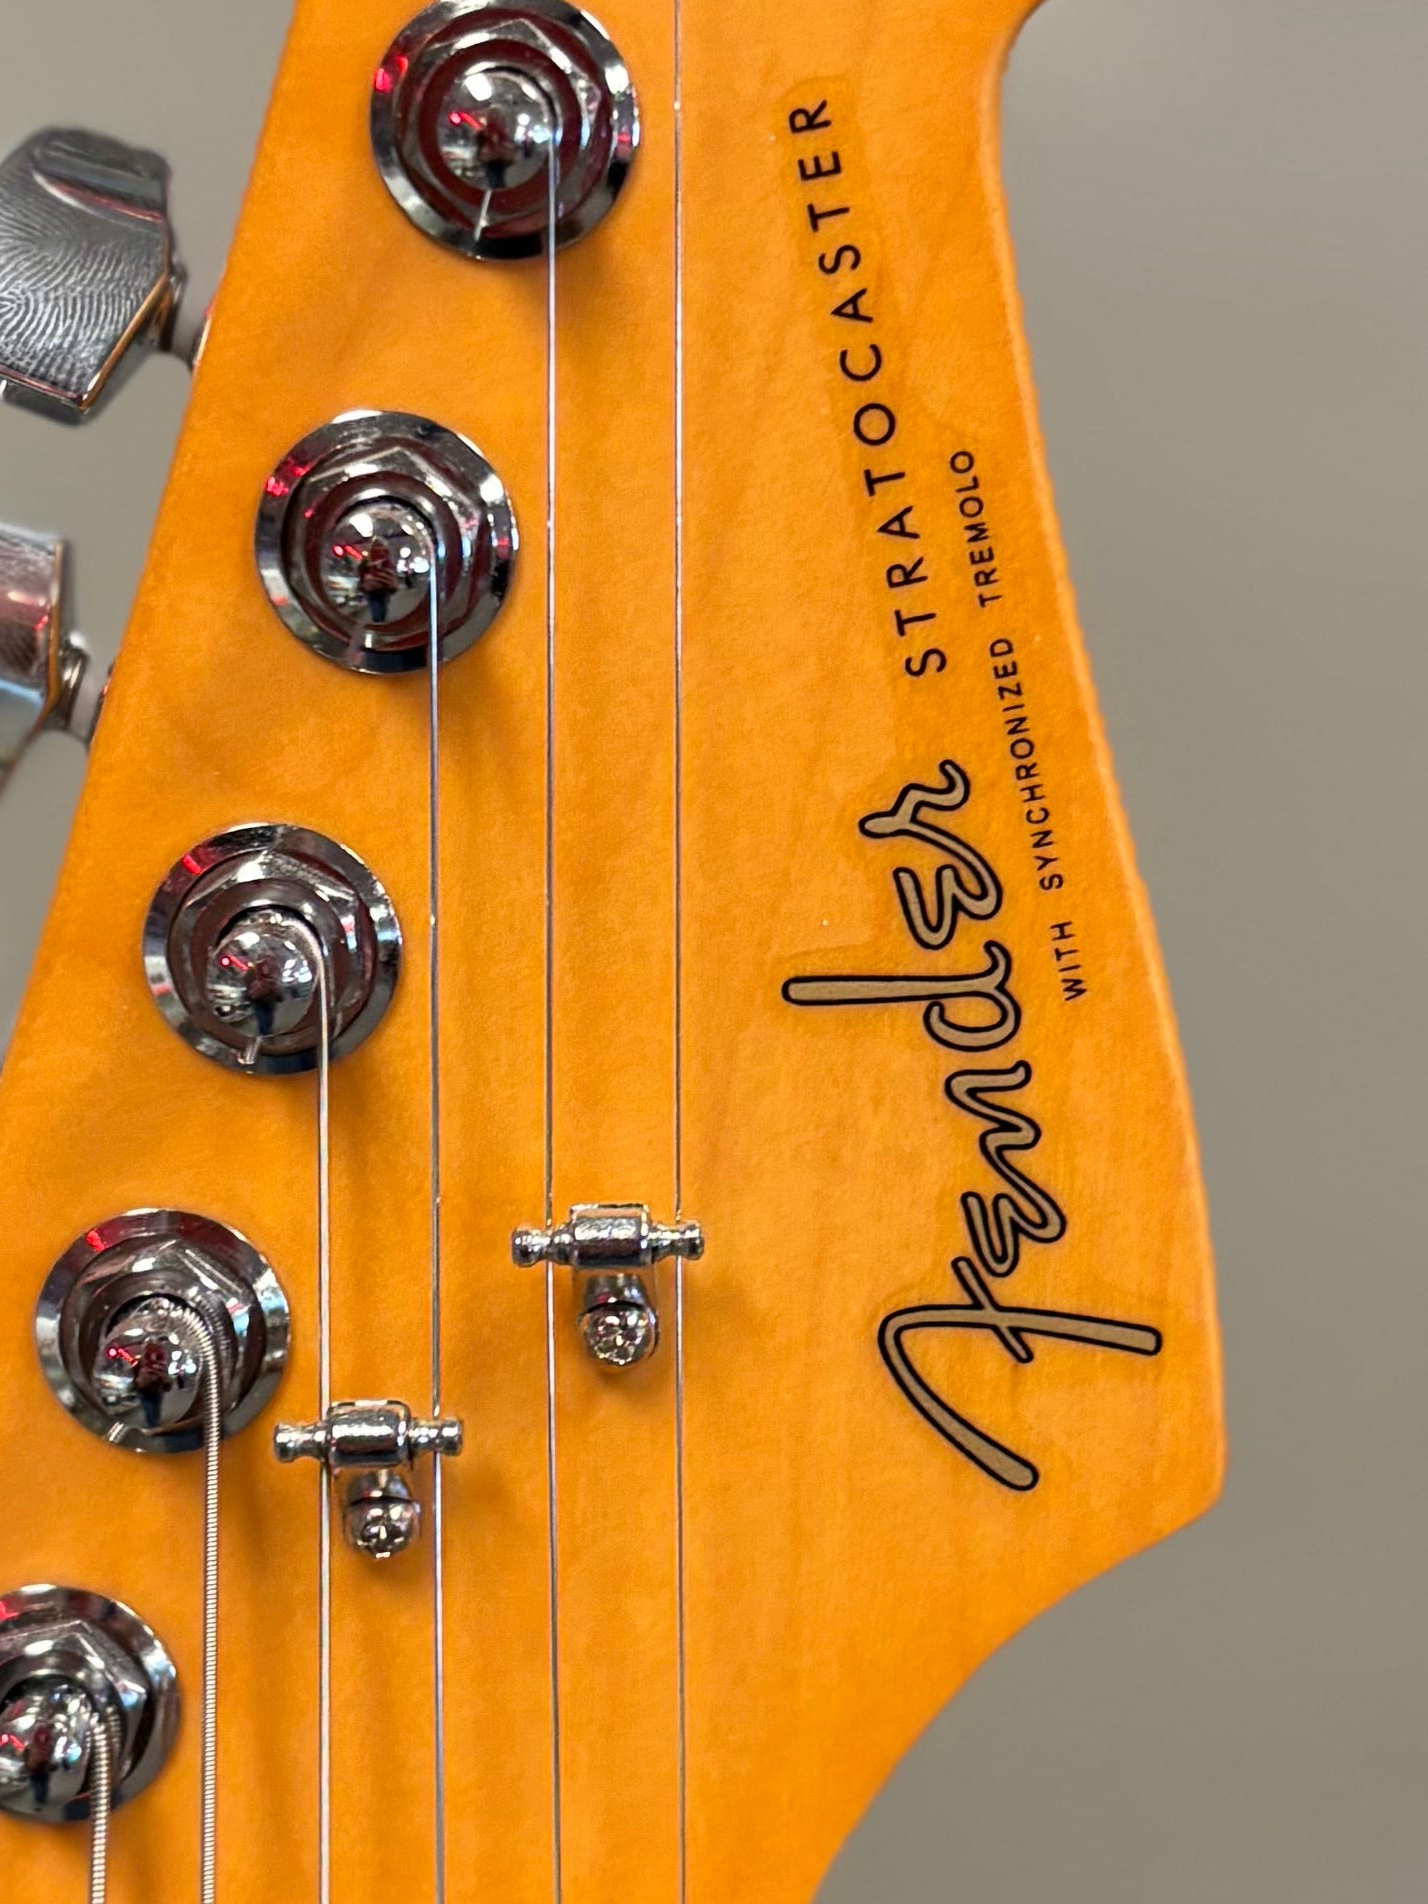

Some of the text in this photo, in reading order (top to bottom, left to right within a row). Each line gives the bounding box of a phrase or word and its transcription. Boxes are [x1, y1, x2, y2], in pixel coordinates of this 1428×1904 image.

[781, 100, 1164, 1492] Fender STRATOCASTER
[950, 451, 1087, 1001] WITH SYNCHRONIZED TREMOLO
